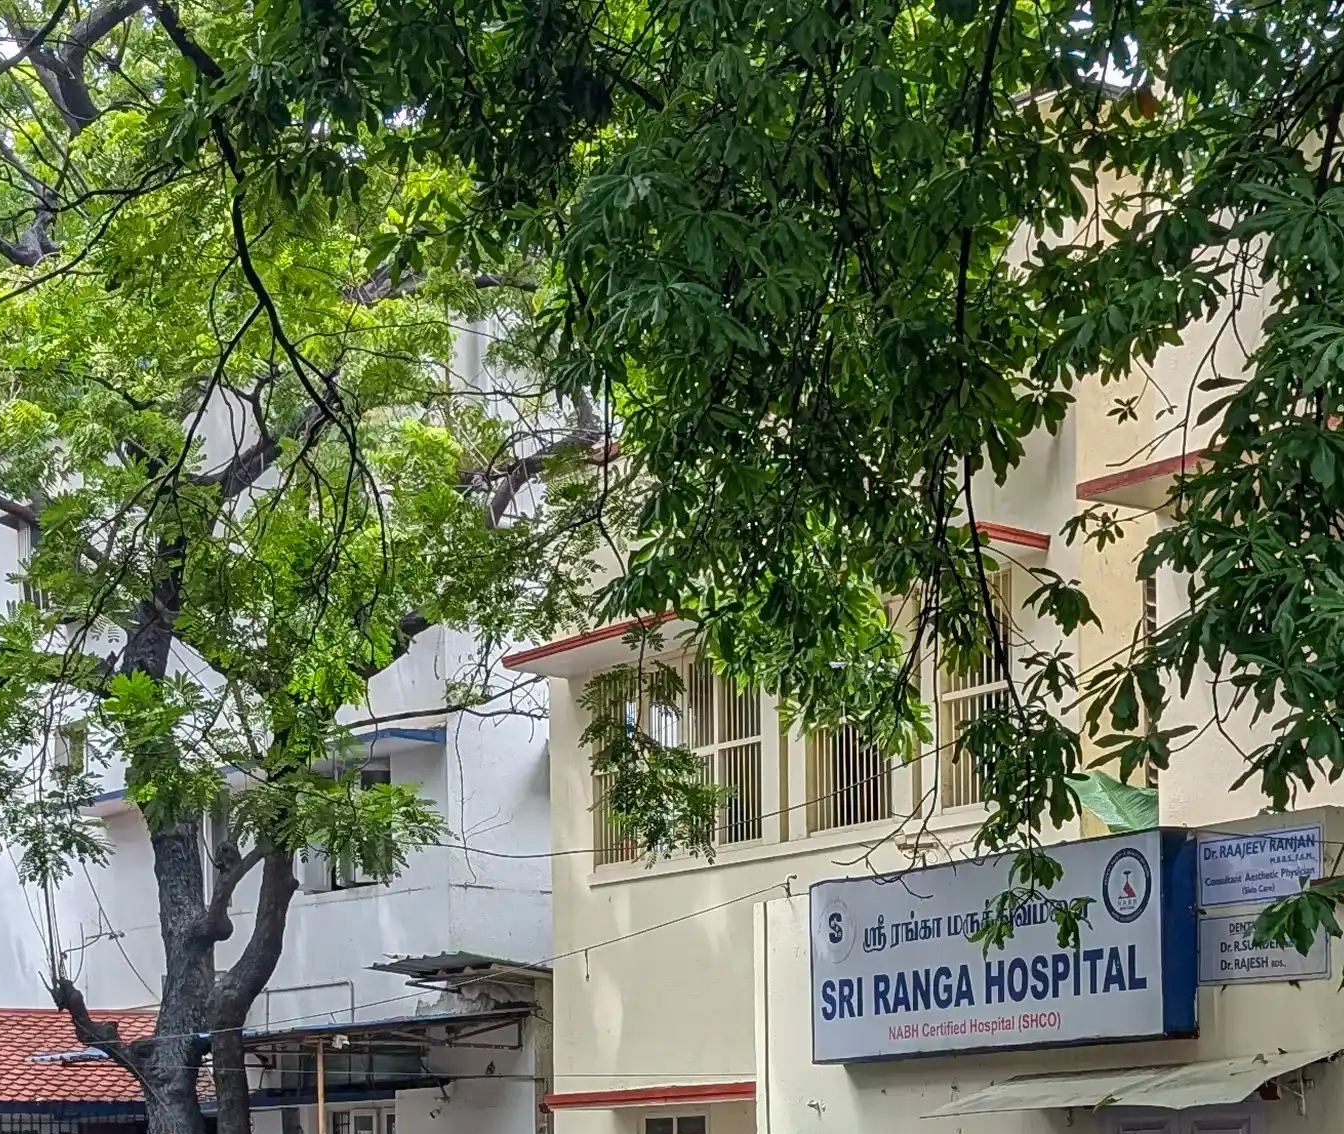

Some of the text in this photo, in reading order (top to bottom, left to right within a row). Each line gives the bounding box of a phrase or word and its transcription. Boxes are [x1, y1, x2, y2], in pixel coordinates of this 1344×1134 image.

[1203, 834, 1316, 861] Dr. RAAJEEV RANJAN
[1204, 865, 1316, 887] Consultant Aesthetic Physician
[890, 910, 943, 948] ரங்கா
[1229, 921, 1254, 934] DENT
[1234, 956, 1269, 972] RAJESH
[821, 944, 1147, 1021] SRI RANGA HOSPITAL
[888, 1012, 1062, 1041] NABH Certified Hospital (SHCO)
